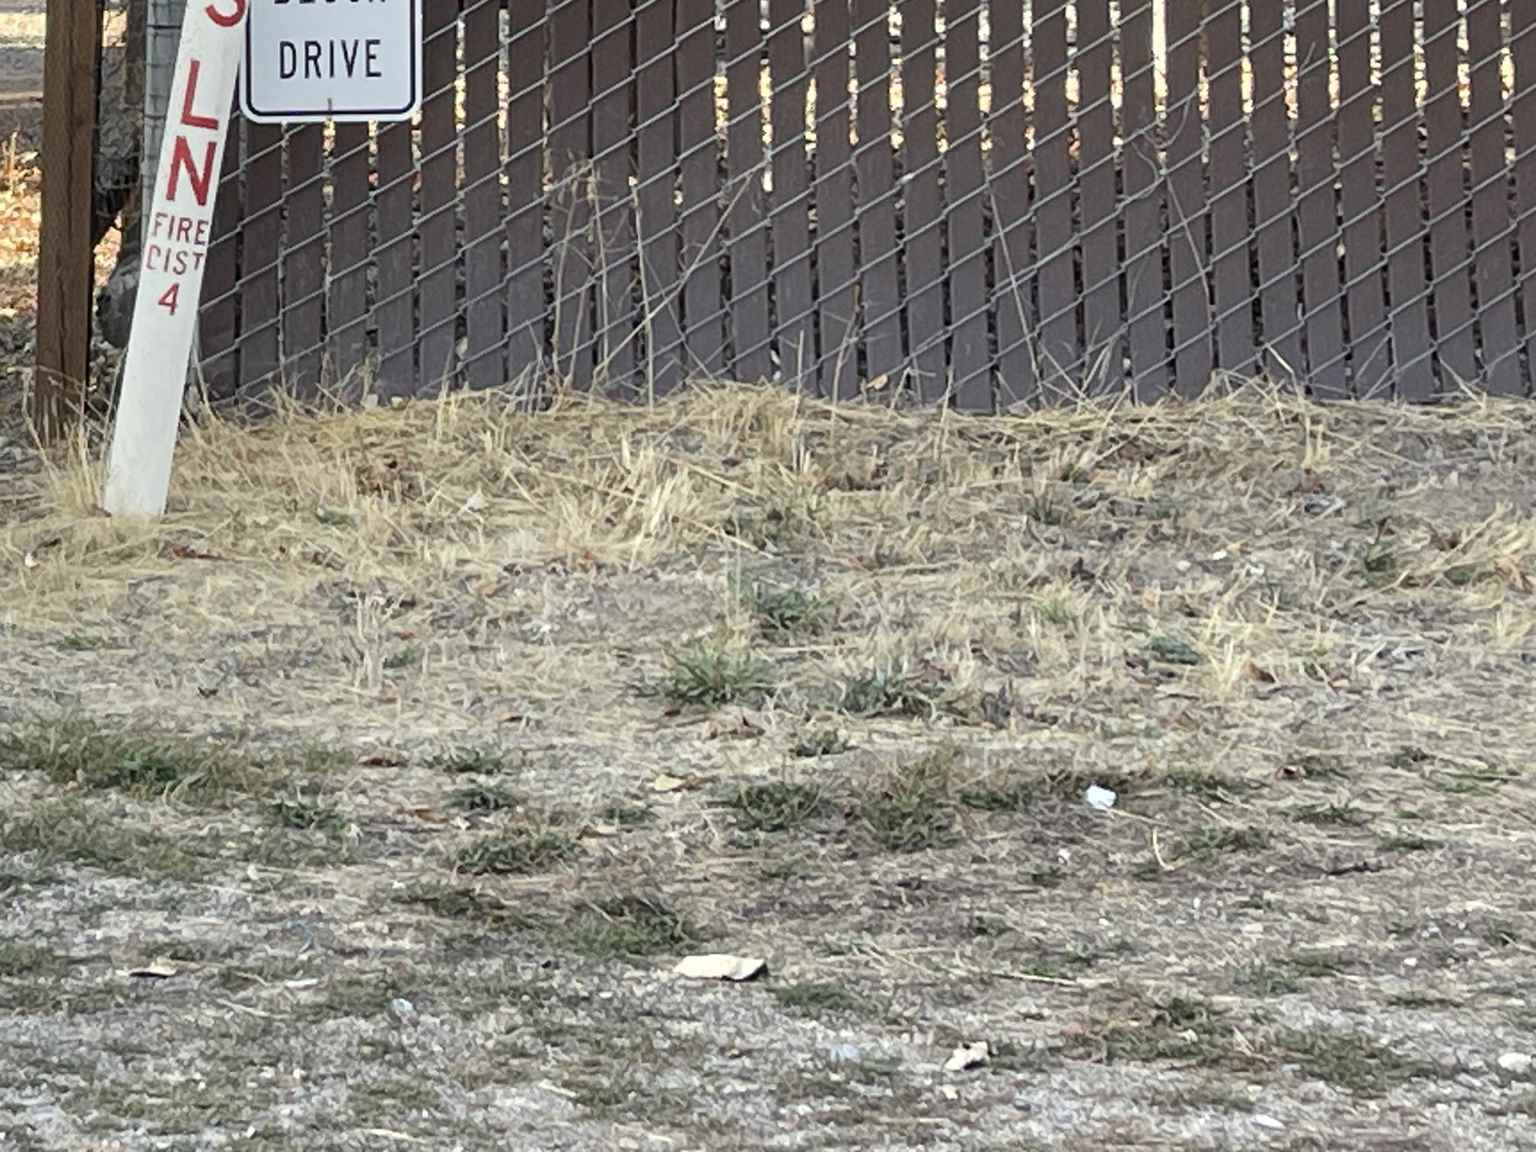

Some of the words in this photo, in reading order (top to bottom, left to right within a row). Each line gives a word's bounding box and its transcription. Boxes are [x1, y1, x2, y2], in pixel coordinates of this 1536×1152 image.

[279, 39, 383, 79] DRIVE
[165, 59, 219, 207] LN
[152, 211, 209, 245] FIRE
[146, 244, 205, 276] DIST
[157, 282, 181, 316] 4
